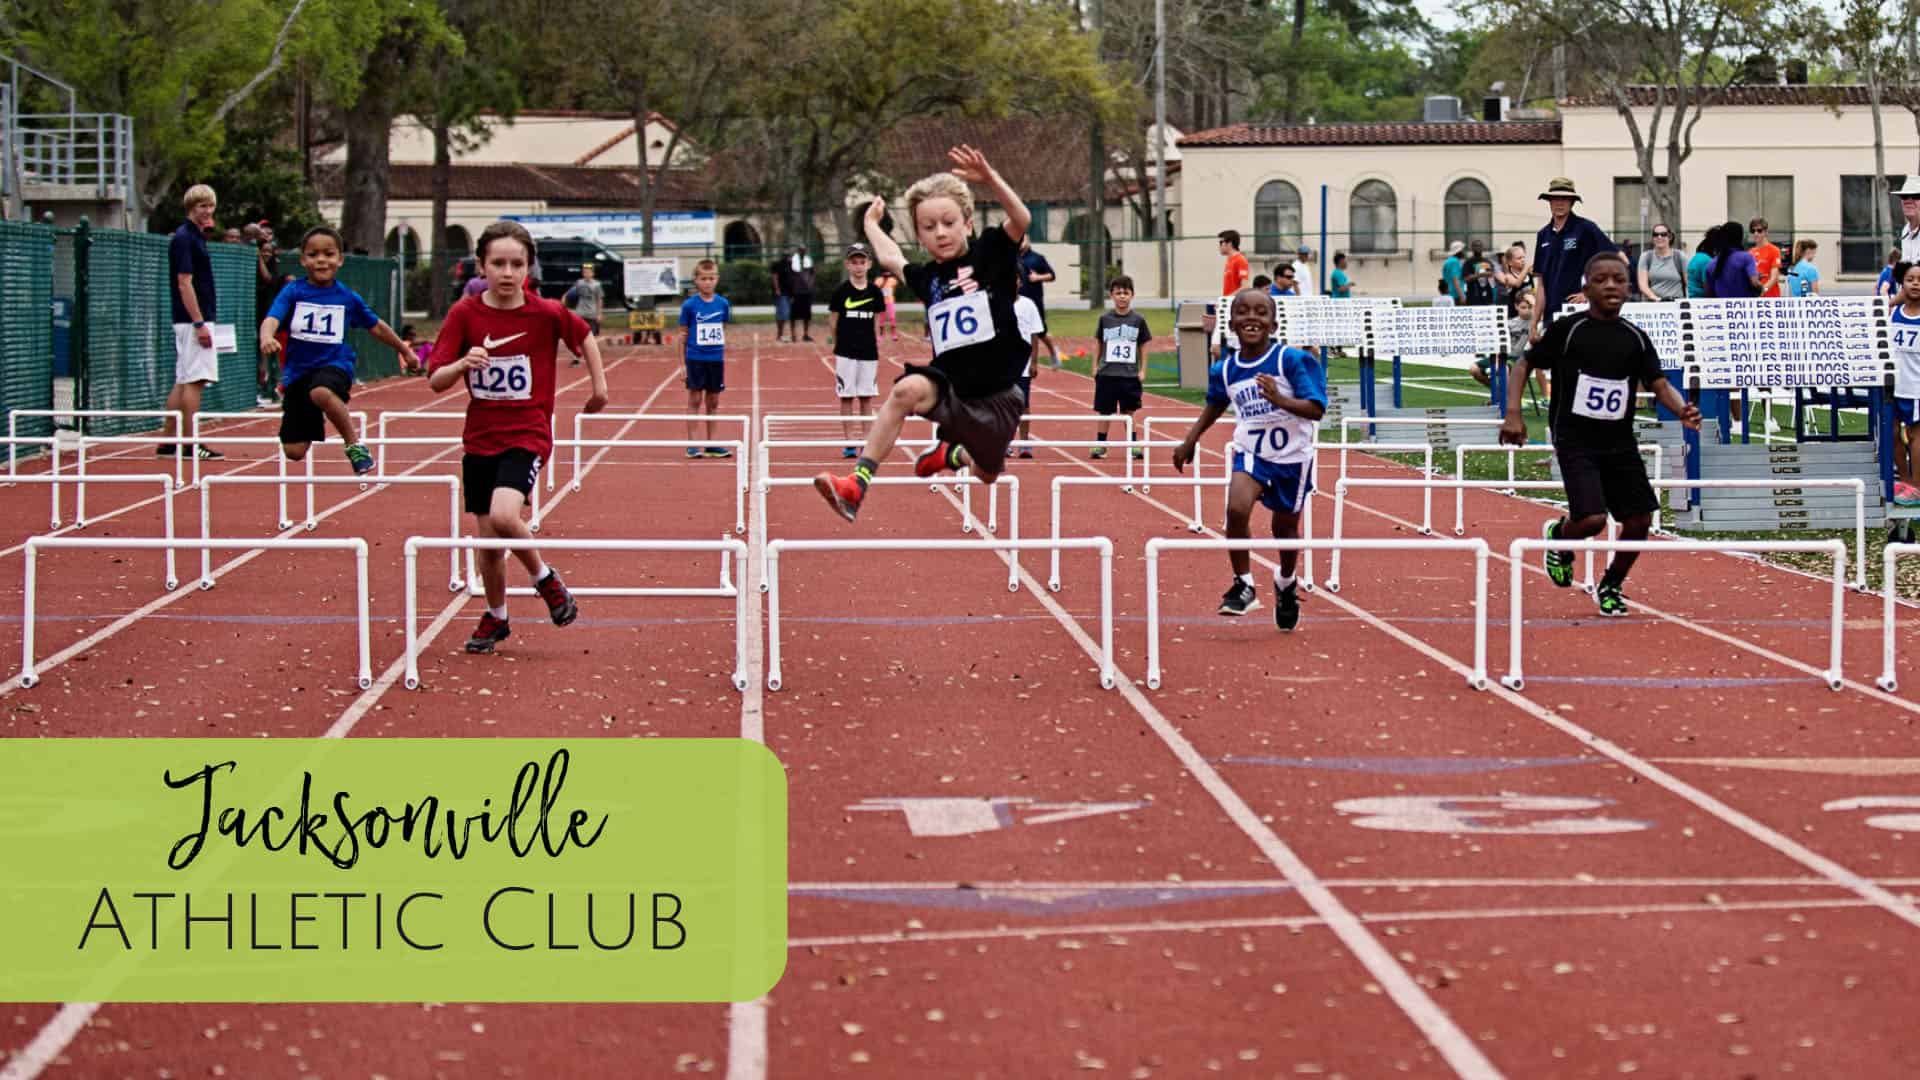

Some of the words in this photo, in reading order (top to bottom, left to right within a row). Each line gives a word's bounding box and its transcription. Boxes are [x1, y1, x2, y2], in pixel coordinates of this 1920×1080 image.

[300, 312, 336, 336] 11
[935, 306, 978, 342] 76
[1894, 330, 1918, 347] 47
[1111, 345, 1131, 359] 43
[472, 365, 526, 392] 126
[1736, 375, 1782, 386] BOLLES
[1785, 373, 1850, 385] BULLDOGS
[1586, 386, 1622, 413] 56
[1247, 426, 1289, 454] 70
